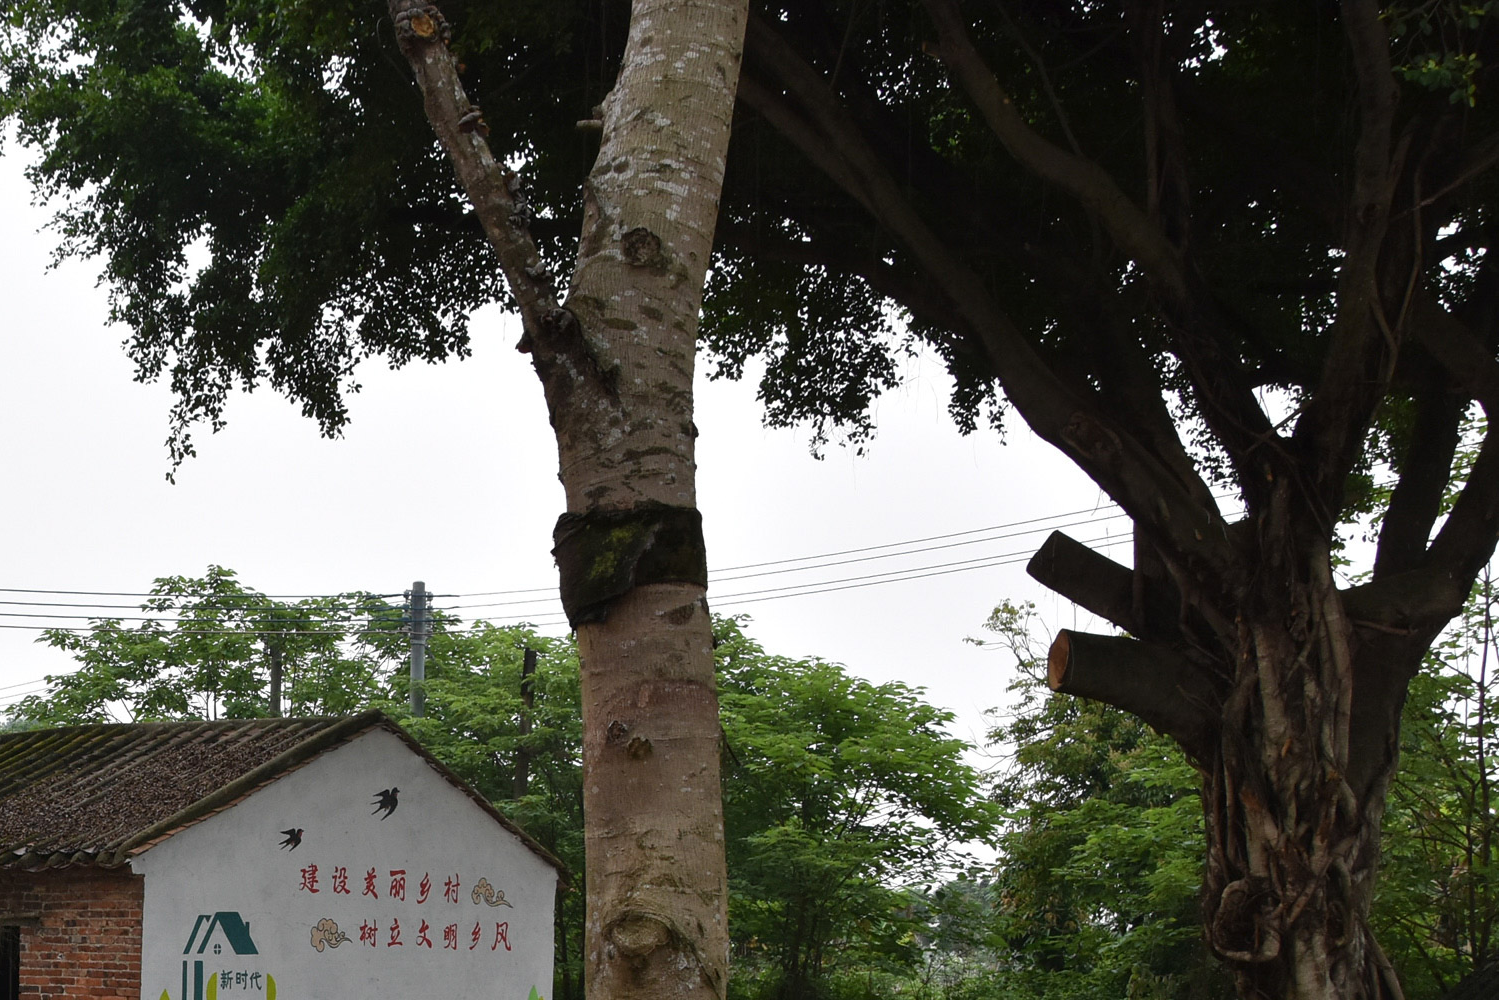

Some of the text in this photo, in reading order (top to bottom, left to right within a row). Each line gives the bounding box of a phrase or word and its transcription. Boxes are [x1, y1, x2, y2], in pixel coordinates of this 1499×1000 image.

[299, 864, 460, 904] 建设美丽乡村
[359, 918, 512, 951] 树立文明乡风
[220, 970, 262, 991] 新时代
